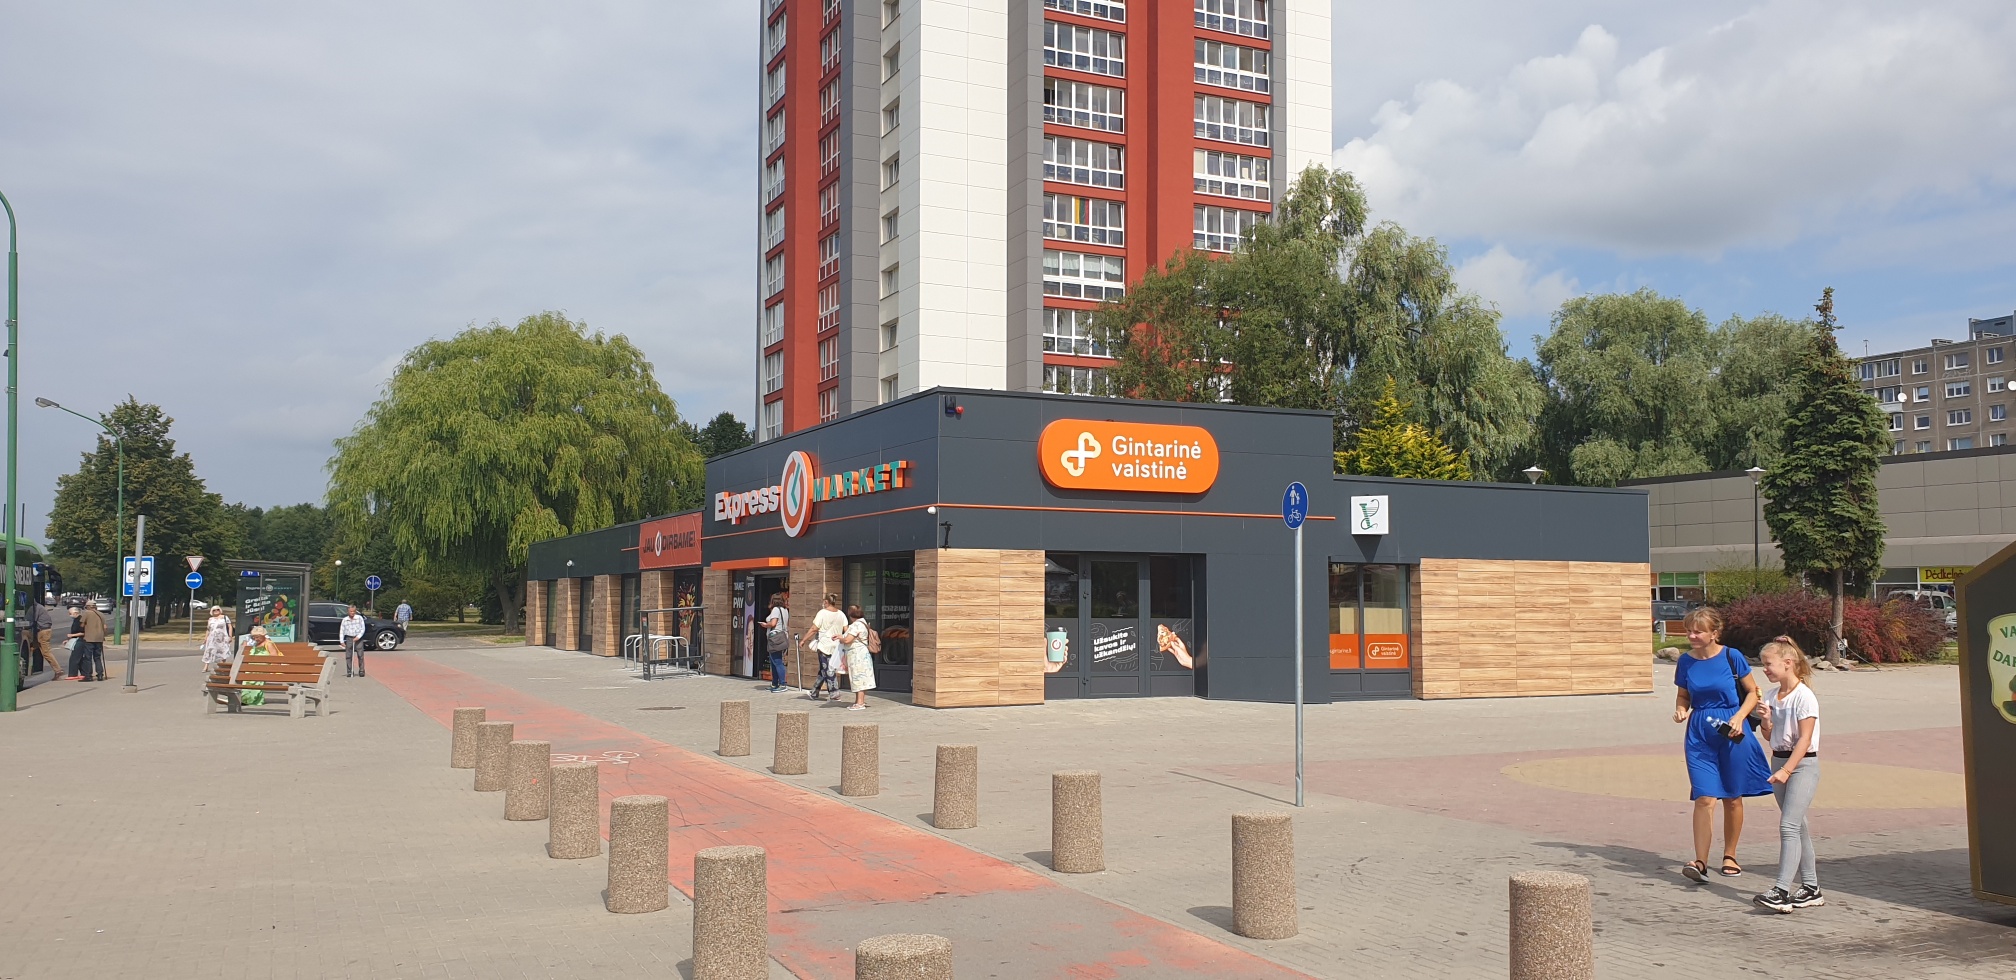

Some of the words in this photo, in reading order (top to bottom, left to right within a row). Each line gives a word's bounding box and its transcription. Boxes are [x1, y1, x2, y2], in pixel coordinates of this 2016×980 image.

[1112, 435, 1202, 459] Gintarinė
[1111, 459, 1187, 480] vaistinė
[714, 485, 782, 525] Express
[813, 460, 906, 503] MARKET
[643, 536, 655, 553] JAU
[662, 530, 696, 551] DIRBAME!
[733, 581, 745, 591] TAKE
[732, 597, 744, 609] PAY
[1094, 632, 1129, 646] Užsukite
[1094, 641, 1119, 652] kavos
[1094, 642, 1136, 659] užkandžių!
